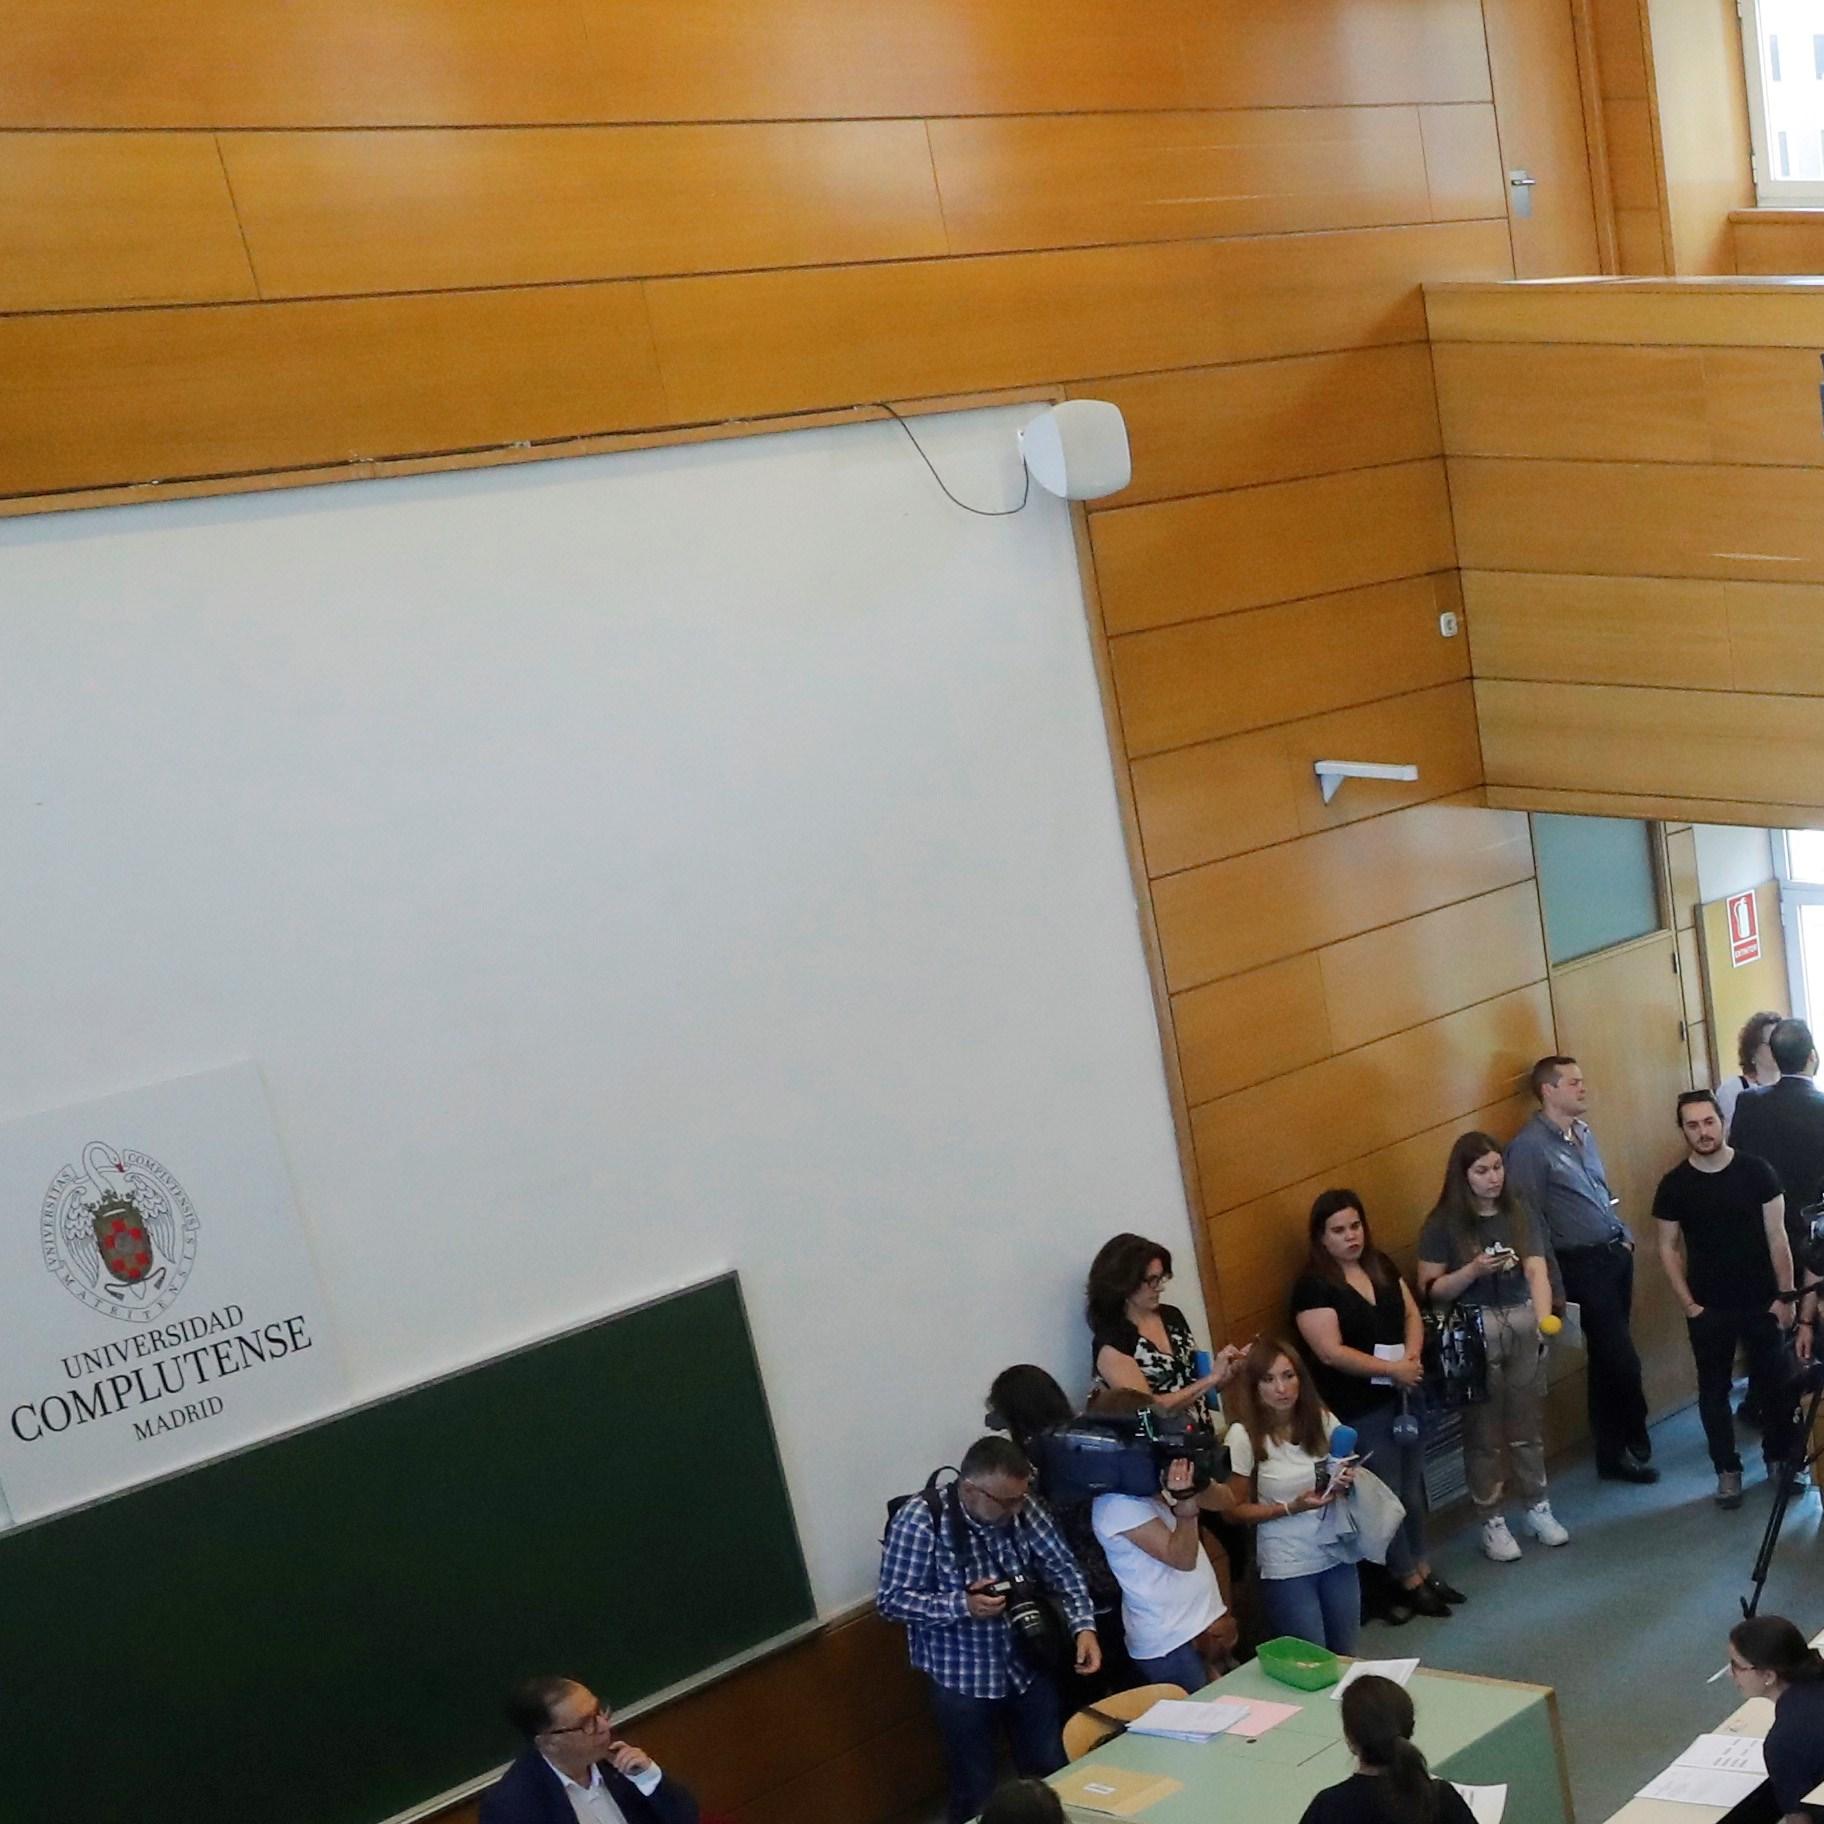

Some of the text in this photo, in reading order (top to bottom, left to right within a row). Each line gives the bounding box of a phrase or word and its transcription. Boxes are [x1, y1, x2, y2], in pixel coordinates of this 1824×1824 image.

[11, 1315, 313, 1442] COMPLUTENSE
[60, 1304, 244, 1380] UNIVERSIDAD
[132, 1395, 225, 1442] MADRID
